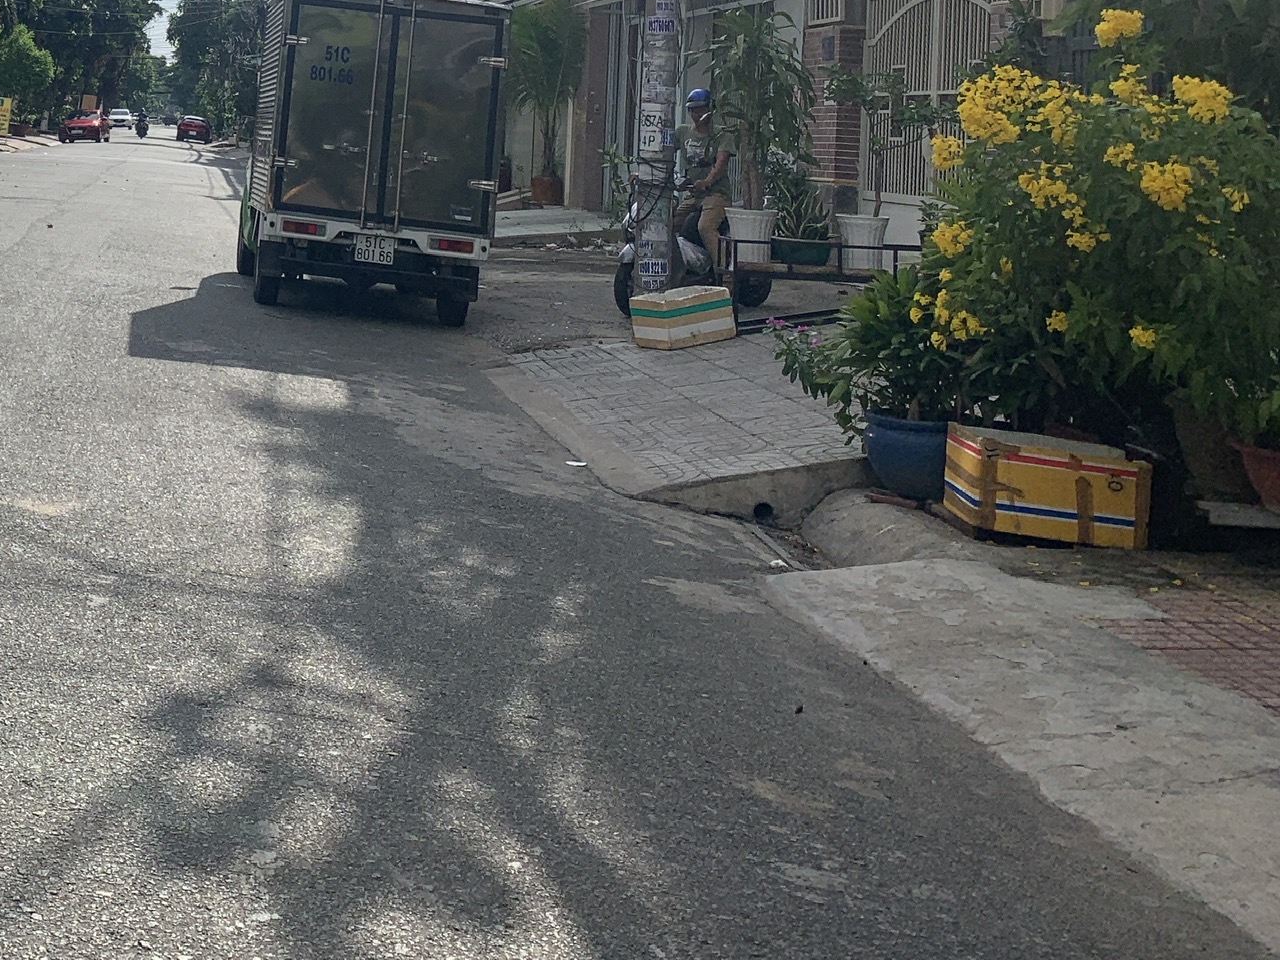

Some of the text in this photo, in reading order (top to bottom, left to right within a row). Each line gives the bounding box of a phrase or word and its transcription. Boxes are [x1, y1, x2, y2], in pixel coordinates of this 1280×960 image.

[325, 45, 350, 63] 51C
[310, 65, 353, 85] 801.66
[365, 236, 386, 249] 51C
[356, 247, 392, 263] 801.66
